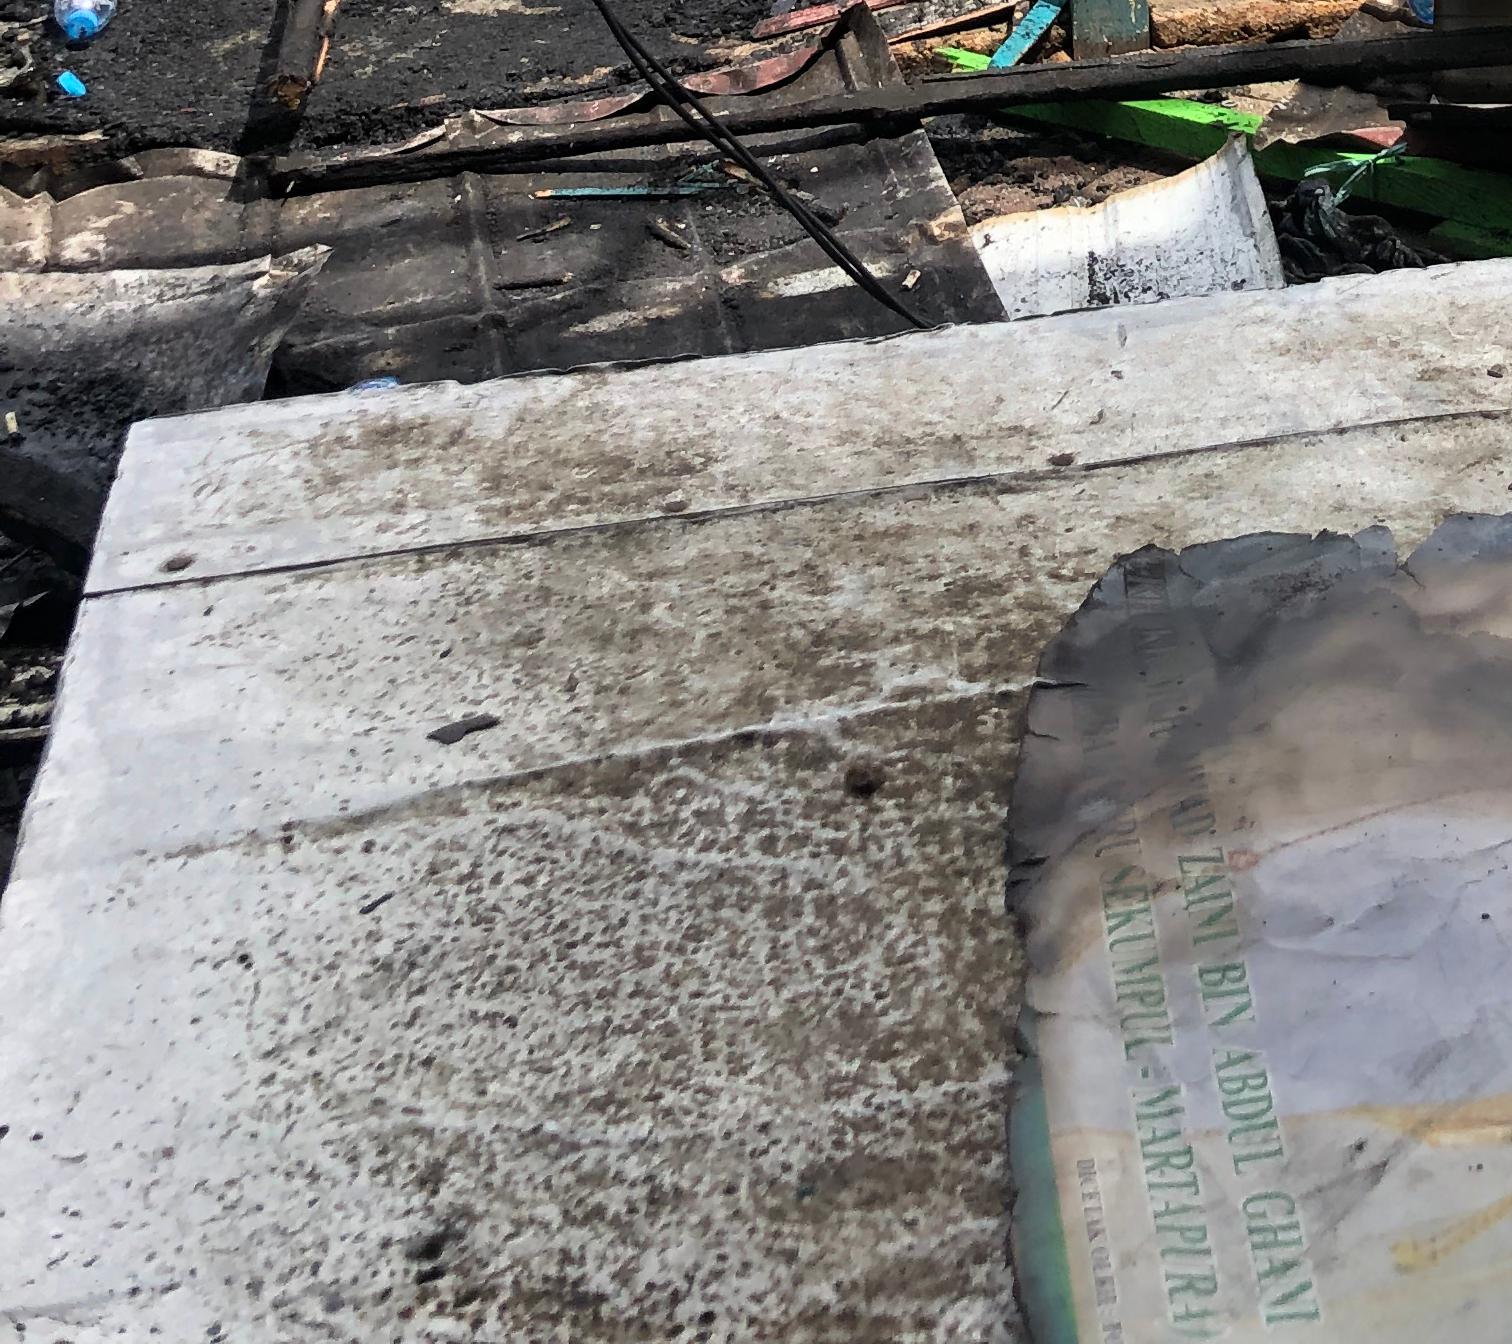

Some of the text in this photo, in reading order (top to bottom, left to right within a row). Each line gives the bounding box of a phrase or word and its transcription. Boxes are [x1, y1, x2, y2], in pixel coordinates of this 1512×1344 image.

[1178, 847, 1239, 946] ZAINI
[1198, 961, 1256, 1028] BIN
[1212, 1048, 1284, 1176] ABDUL
[1241, 1190, 1321, 1325] GHANI
